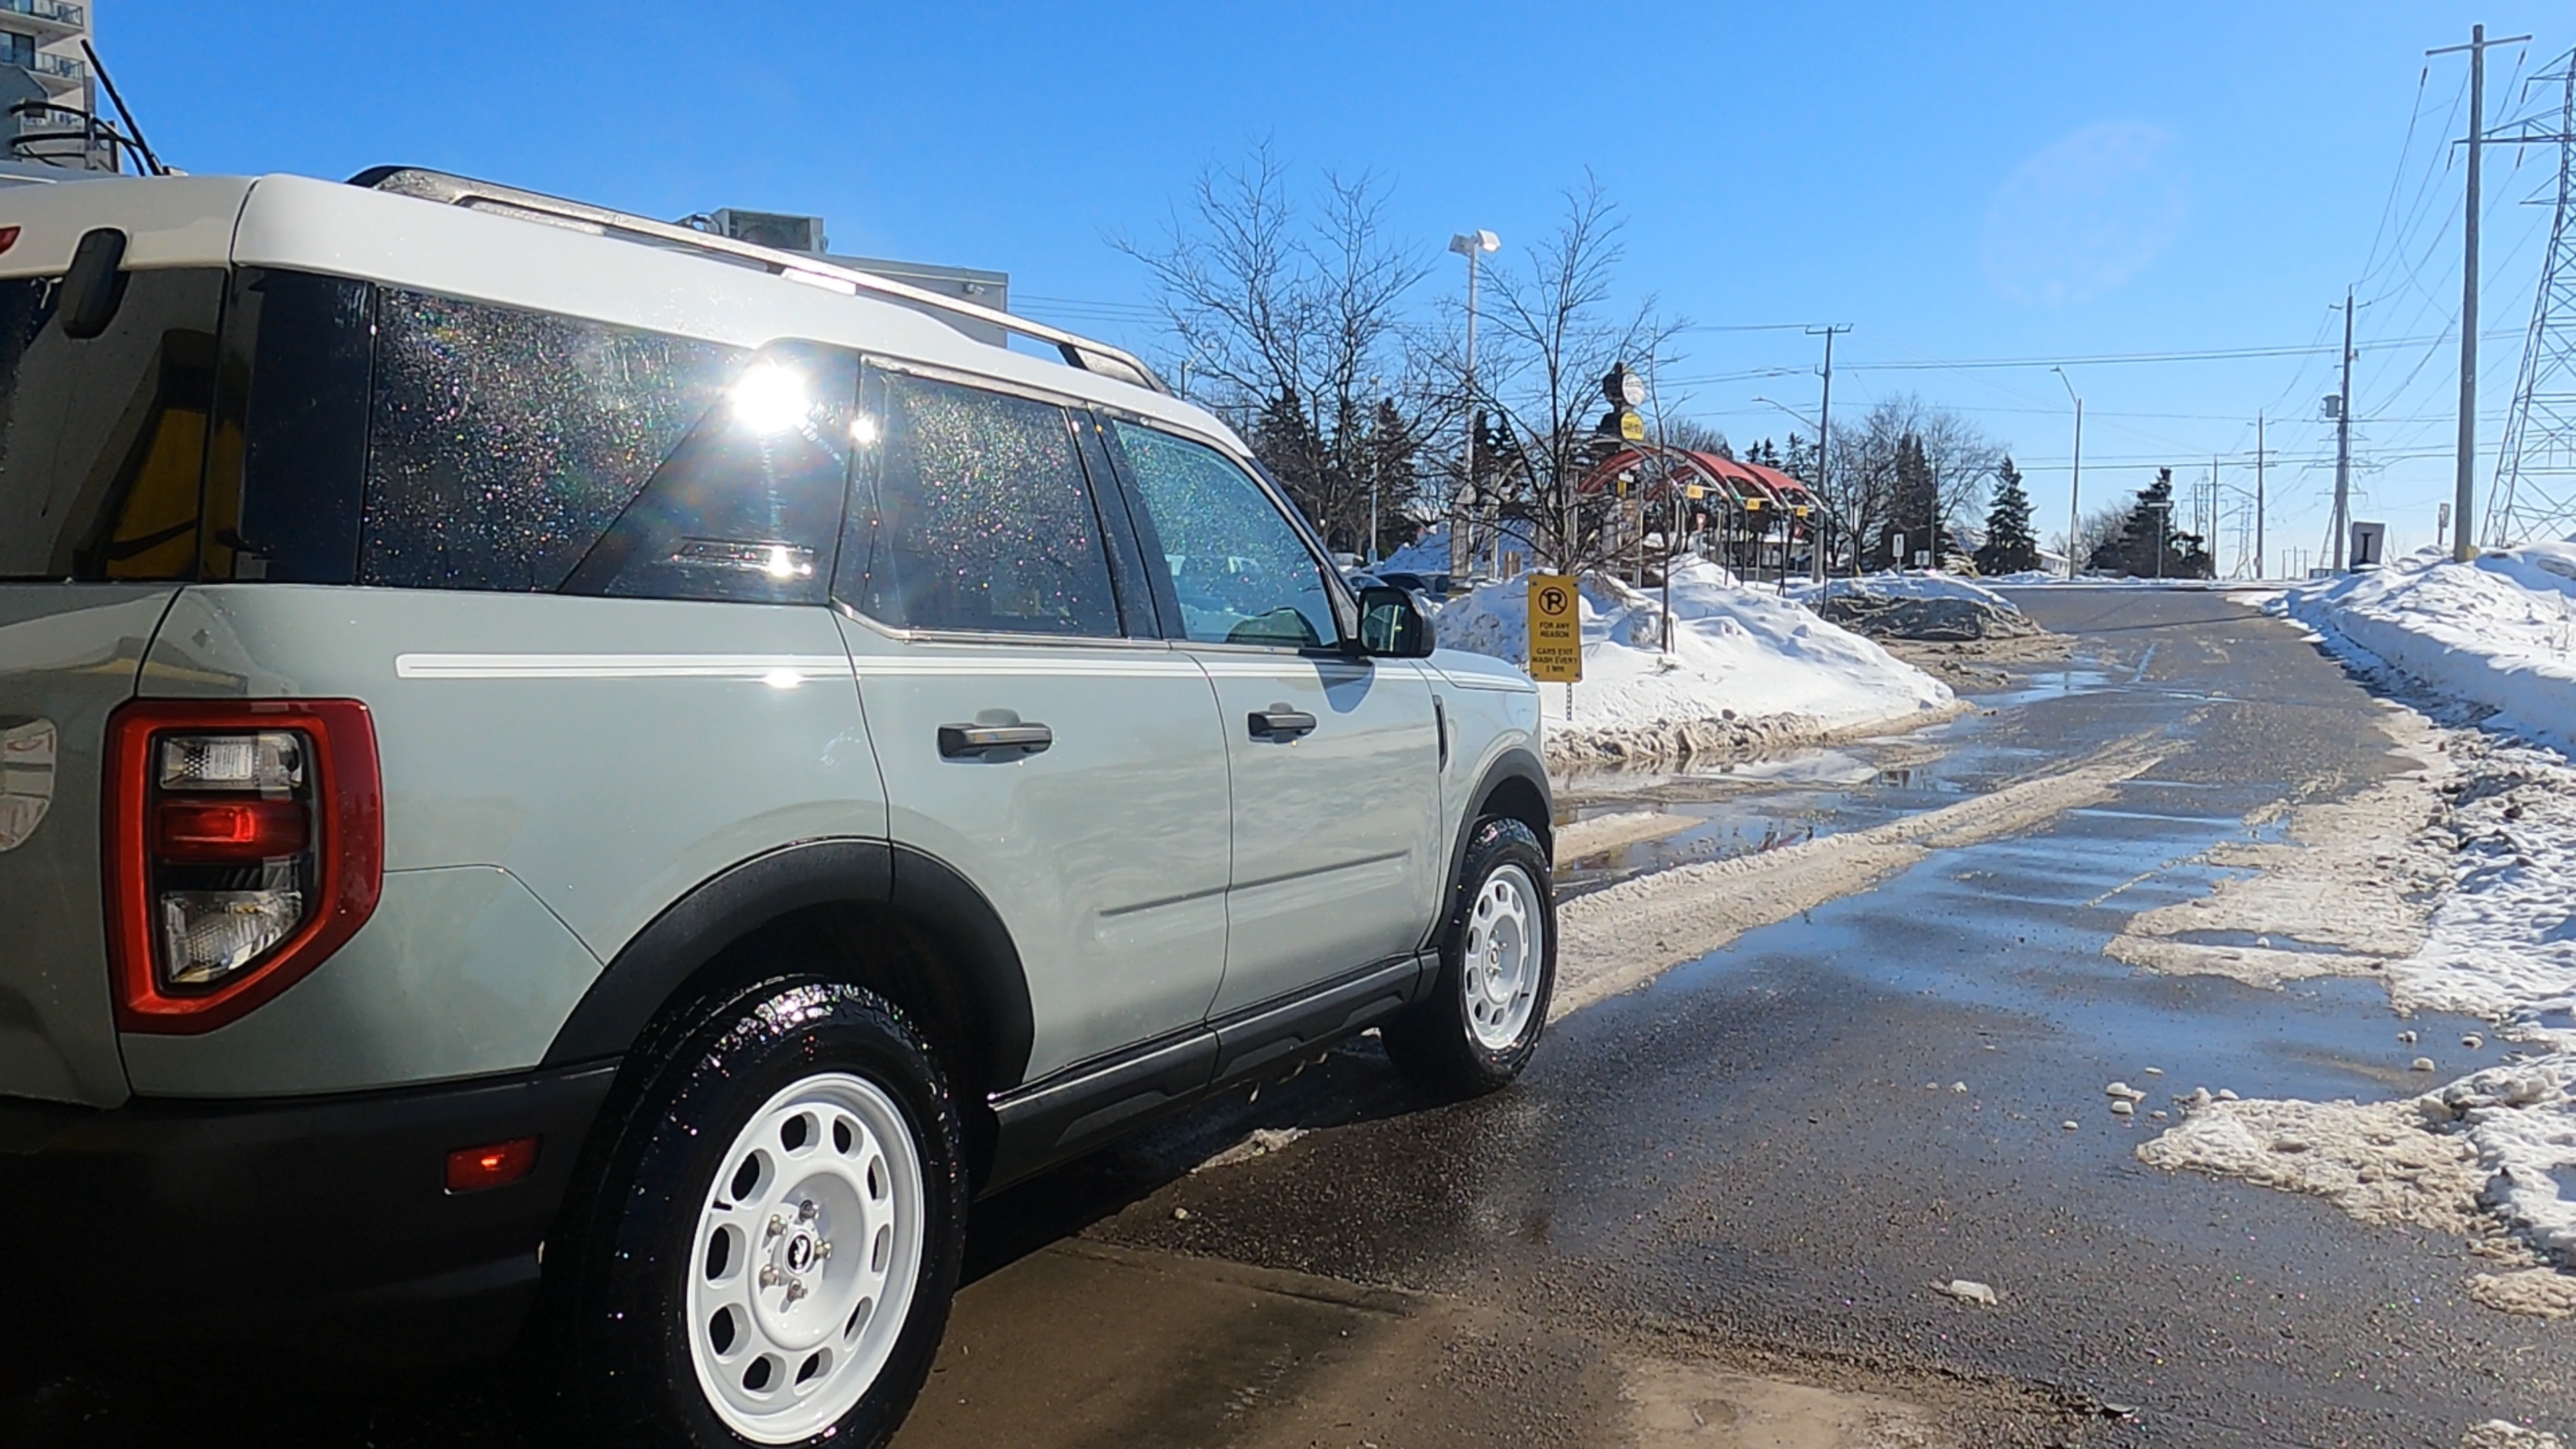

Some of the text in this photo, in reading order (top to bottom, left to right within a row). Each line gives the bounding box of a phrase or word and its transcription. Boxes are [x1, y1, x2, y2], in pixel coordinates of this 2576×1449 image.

[1537, 647, 1573, 655] CARS EXIT
[1555, 656, 1577, 665] EVERY
